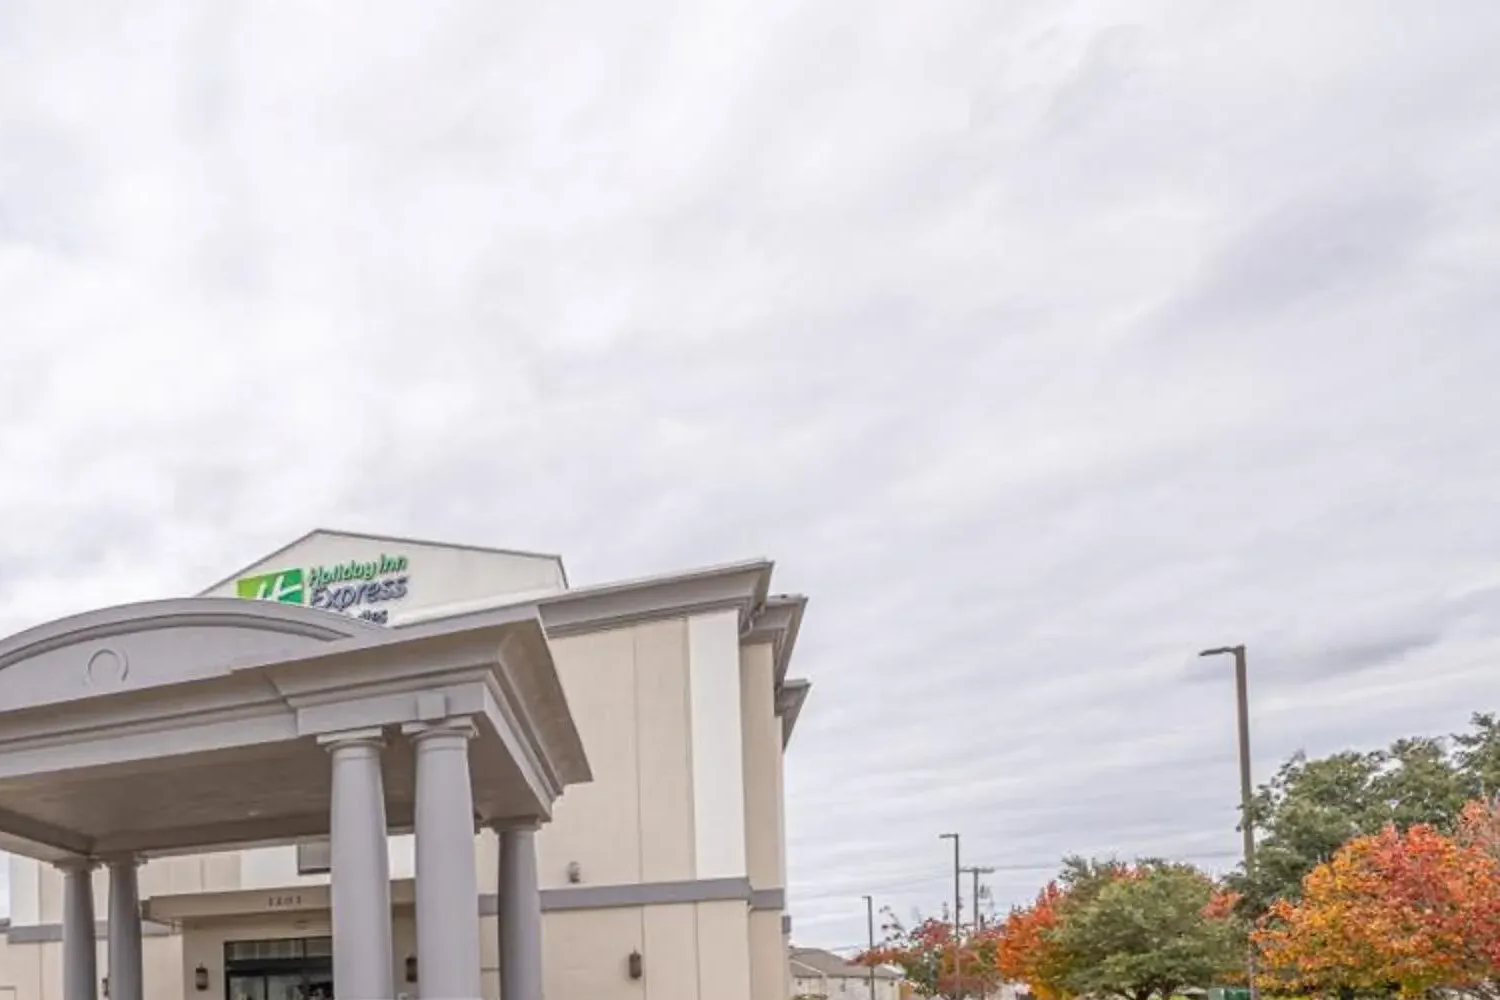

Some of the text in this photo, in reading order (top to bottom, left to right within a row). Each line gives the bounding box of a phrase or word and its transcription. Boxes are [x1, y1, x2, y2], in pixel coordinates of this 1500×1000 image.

[308, 553, 408, 587] Holiday Inn
[311, 575, 409, 612] Express
